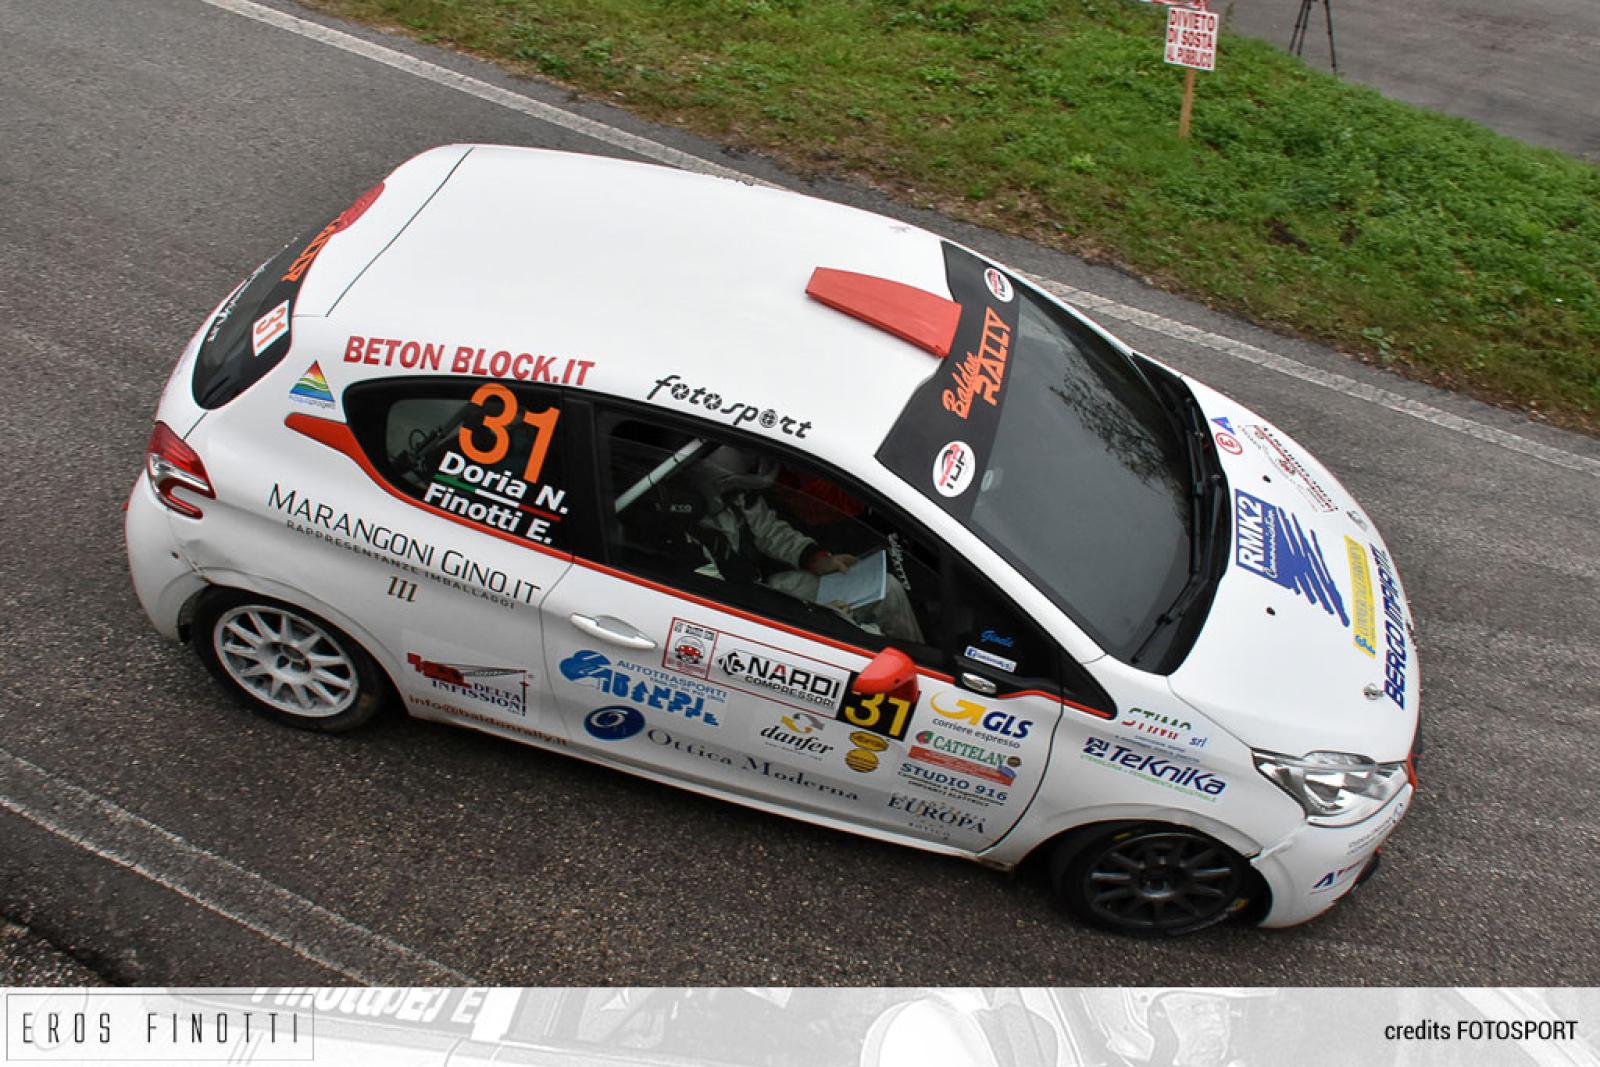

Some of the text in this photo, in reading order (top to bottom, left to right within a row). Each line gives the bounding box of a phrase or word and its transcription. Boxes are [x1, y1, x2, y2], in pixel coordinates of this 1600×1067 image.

[1168, 27, 1213, 49] DI SOSTA
[1169, 9, 1215, 31] DIVIETO
[343, 335, 596, 386] BETON BLOCK.IT
[974, 306, 1012, 407] RALLY
[646, 374, 813, 439] fotosport
[458, 382, 561, 484] 31
[438, 450, 569, 515] Doria N.
[423, 482, 554, 545] Finotti E.
[1238, 496, 1264, 572] RMK2
[268, 482, 542, 604] MARANGONI GINO.IT
[286, 519, 515, 610] RAPPRESENTANZE IMBALLAGGI
[474, 682, 521, 703] DELTA
[616, 660, 729, 699] AUTOTRASPORTI
[745, 674, 835, 707] COMPRESSORI
[746, 655, 840, 699] NARDI
[844, 692, 911, 737] 31
[932, 718, 1021, 749] corriere espresso
[982, 710, 1034, 740] GLS
[760, 725, 834, 754] danfer
[933, 735, 1007, 767] CATTELAN
[647, 728, 733, 766] Ottica
[741, 755, 859, 801] Moderna
[900, 761, 970, 790] STUDIO
[974, 784, 1009, 802] 916
[888, 792, 986, 834] EUROPA
